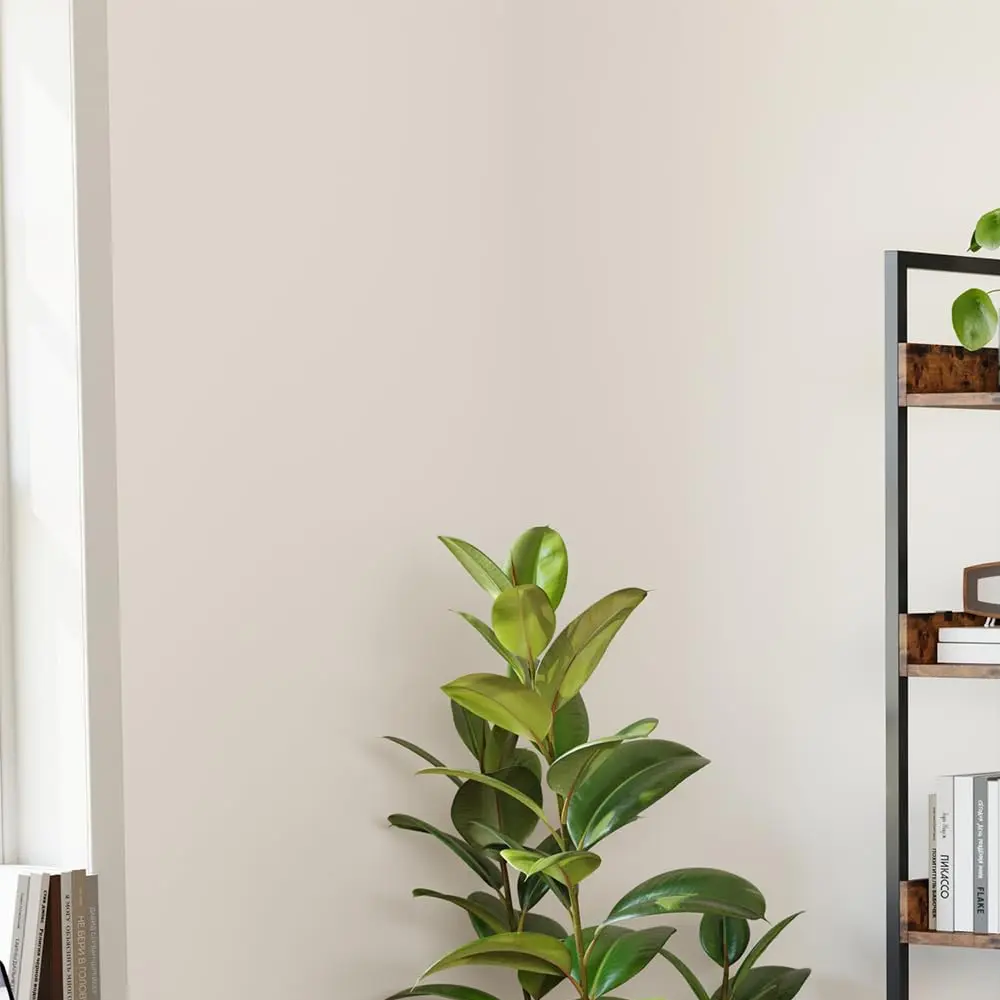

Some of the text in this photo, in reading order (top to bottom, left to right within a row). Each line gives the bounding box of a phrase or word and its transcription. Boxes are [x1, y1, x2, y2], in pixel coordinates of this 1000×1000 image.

[940, 854, 949, 899] ПИКАССО
[976, 886, 985, 915] FLAKE
[78, 916, 85, 928] НЕ
[78, 930, 86, 955] БЕРИ
[79, 956, 86, 965] В
